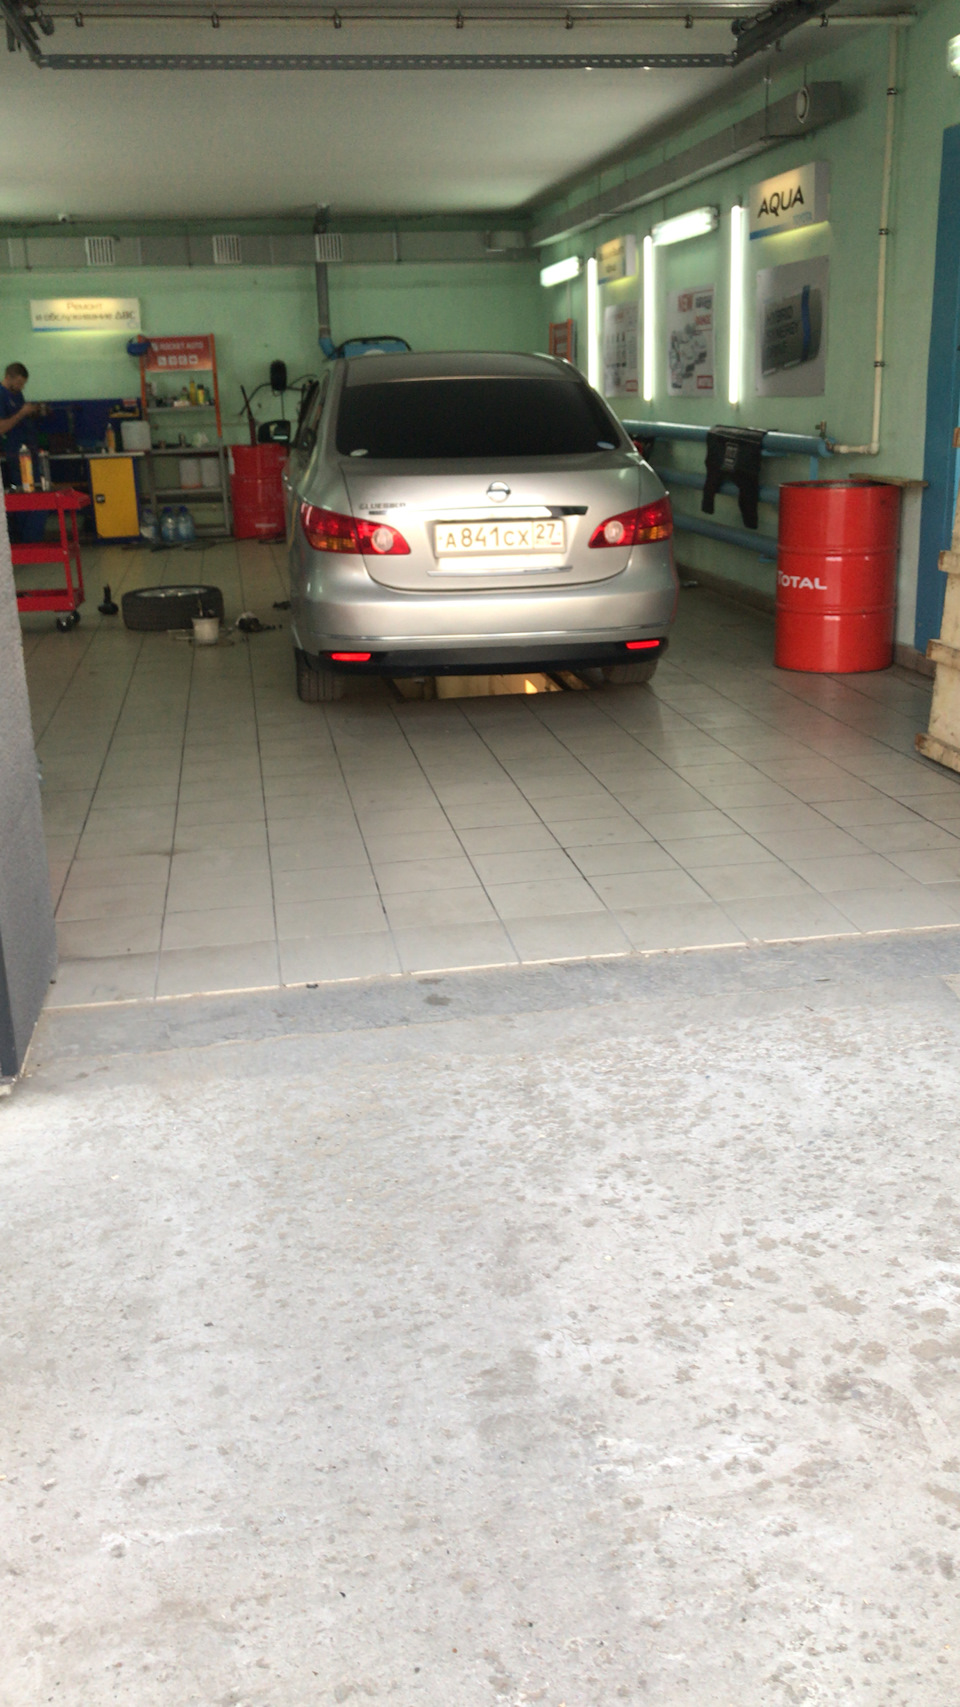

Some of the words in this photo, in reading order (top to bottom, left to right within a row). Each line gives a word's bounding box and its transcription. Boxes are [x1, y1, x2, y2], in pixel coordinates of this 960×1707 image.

[757, 185, 804, 219] AQUA
[66, 302, 103, 311] Ремонт
[115, 310, 136, 320] ДВС
[536, 523, 556, 540] 27
[777, 570, 828, 590] TOTAL
